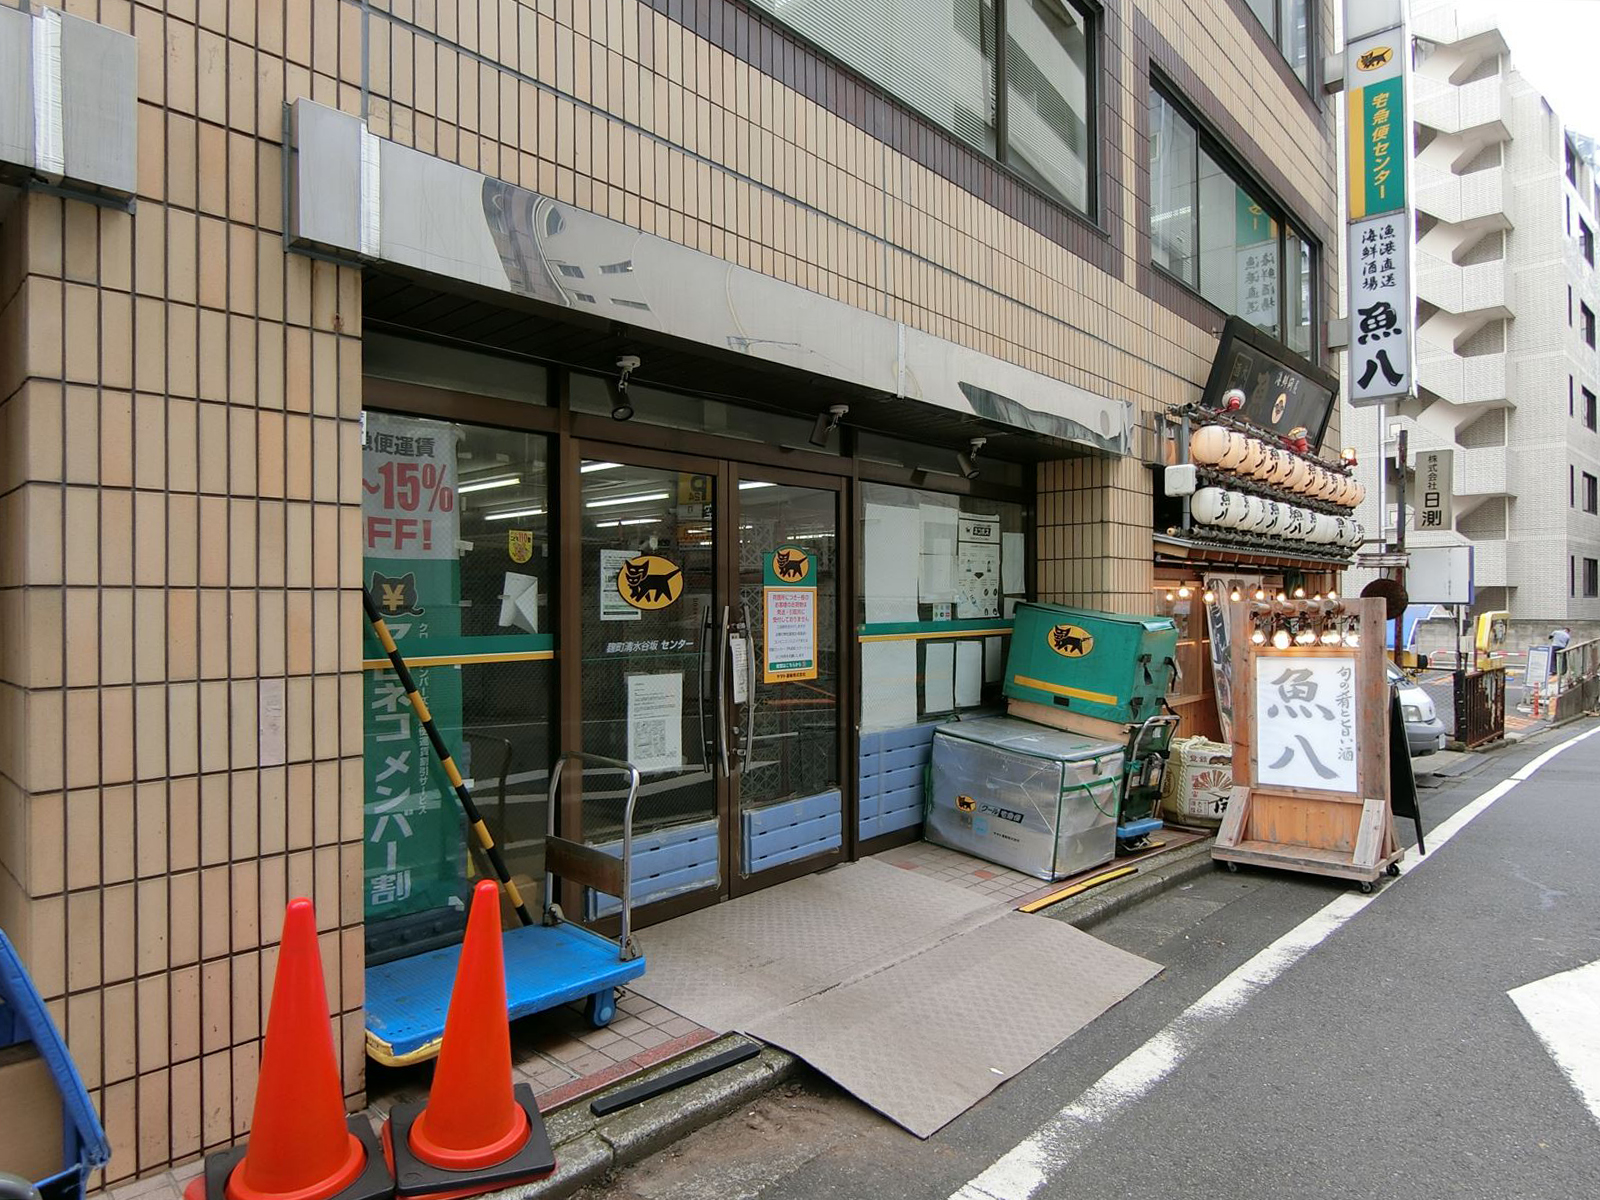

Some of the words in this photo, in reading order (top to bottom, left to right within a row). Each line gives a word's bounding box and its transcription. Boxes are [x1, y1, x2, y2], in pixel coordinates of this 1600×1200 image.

[1372, 92, 1391, 200] 宅急便センター
[1361, 228, 1379, 291] 海鮮酒場
[1379, 224, 1397, 289] 漁港直送
[1357, 300, 1405, 391] 魚八
[363, 515, 433, 551] FF!
[661, 639, 694, 651] センター
[1267, 667, 1340, 781] 魚八
